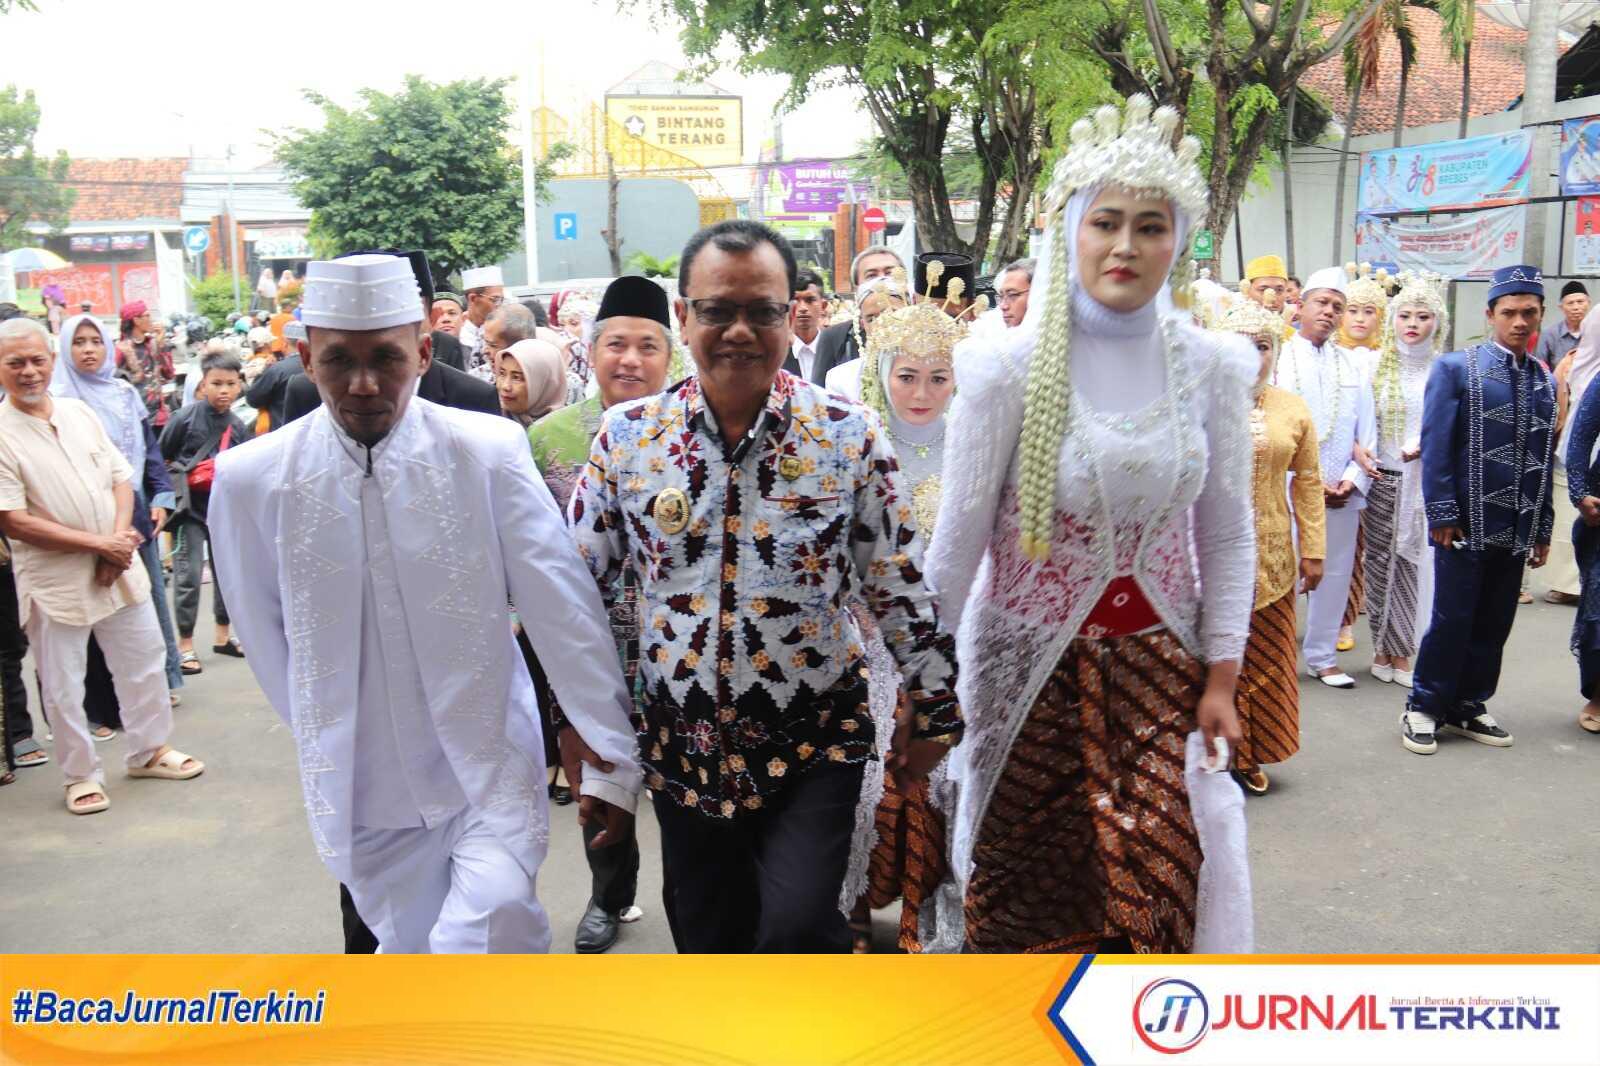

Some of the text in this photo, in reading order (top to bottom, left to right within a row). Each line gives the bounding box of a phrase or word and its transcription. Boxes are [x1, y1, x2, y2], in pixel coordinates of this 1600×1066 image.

[656, 116, 725, 129] BINTANG
[657, 132, 726, 145] TERANG
[559, 218, 573, 235] P
